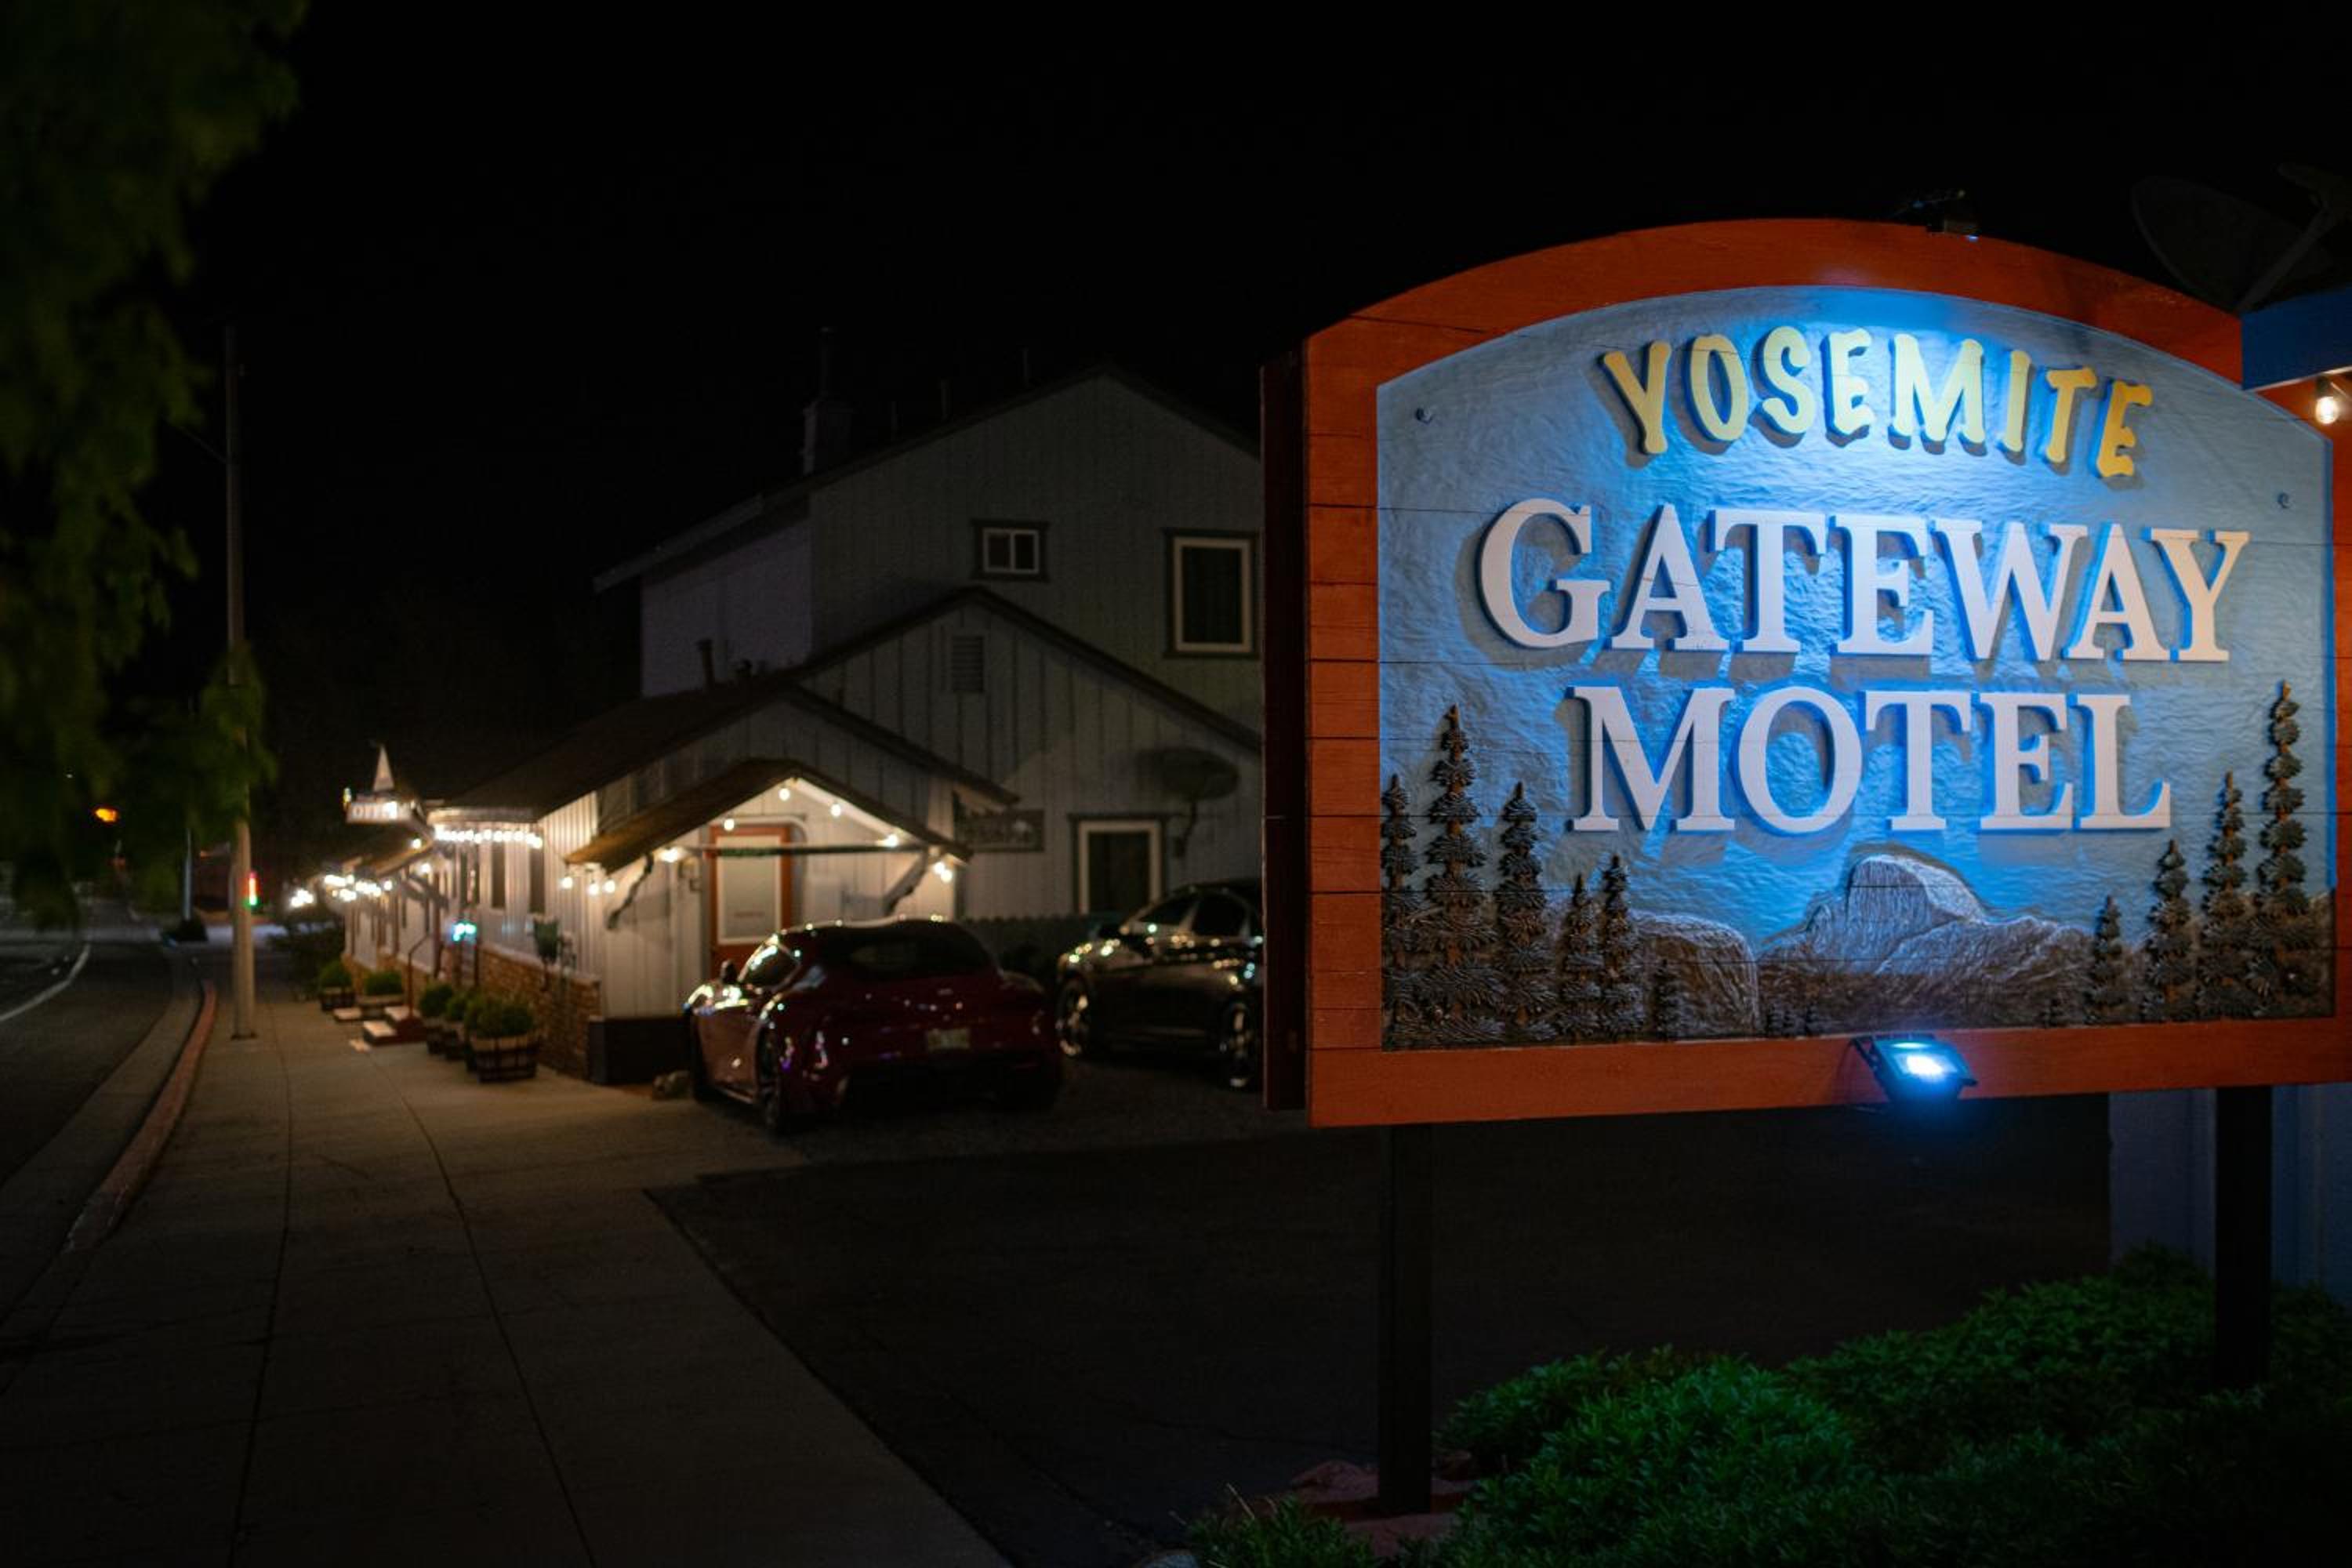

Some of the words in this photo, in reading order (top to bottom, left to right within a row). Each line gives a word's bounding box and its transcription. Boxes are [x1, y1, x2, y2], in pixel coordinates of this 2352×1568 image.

[1602, 327, 2153, 477] YOSEMITE
[1480, 498, 2250, 662] GATEWAY
[1571, 684, 2171, 832] MOTEL
